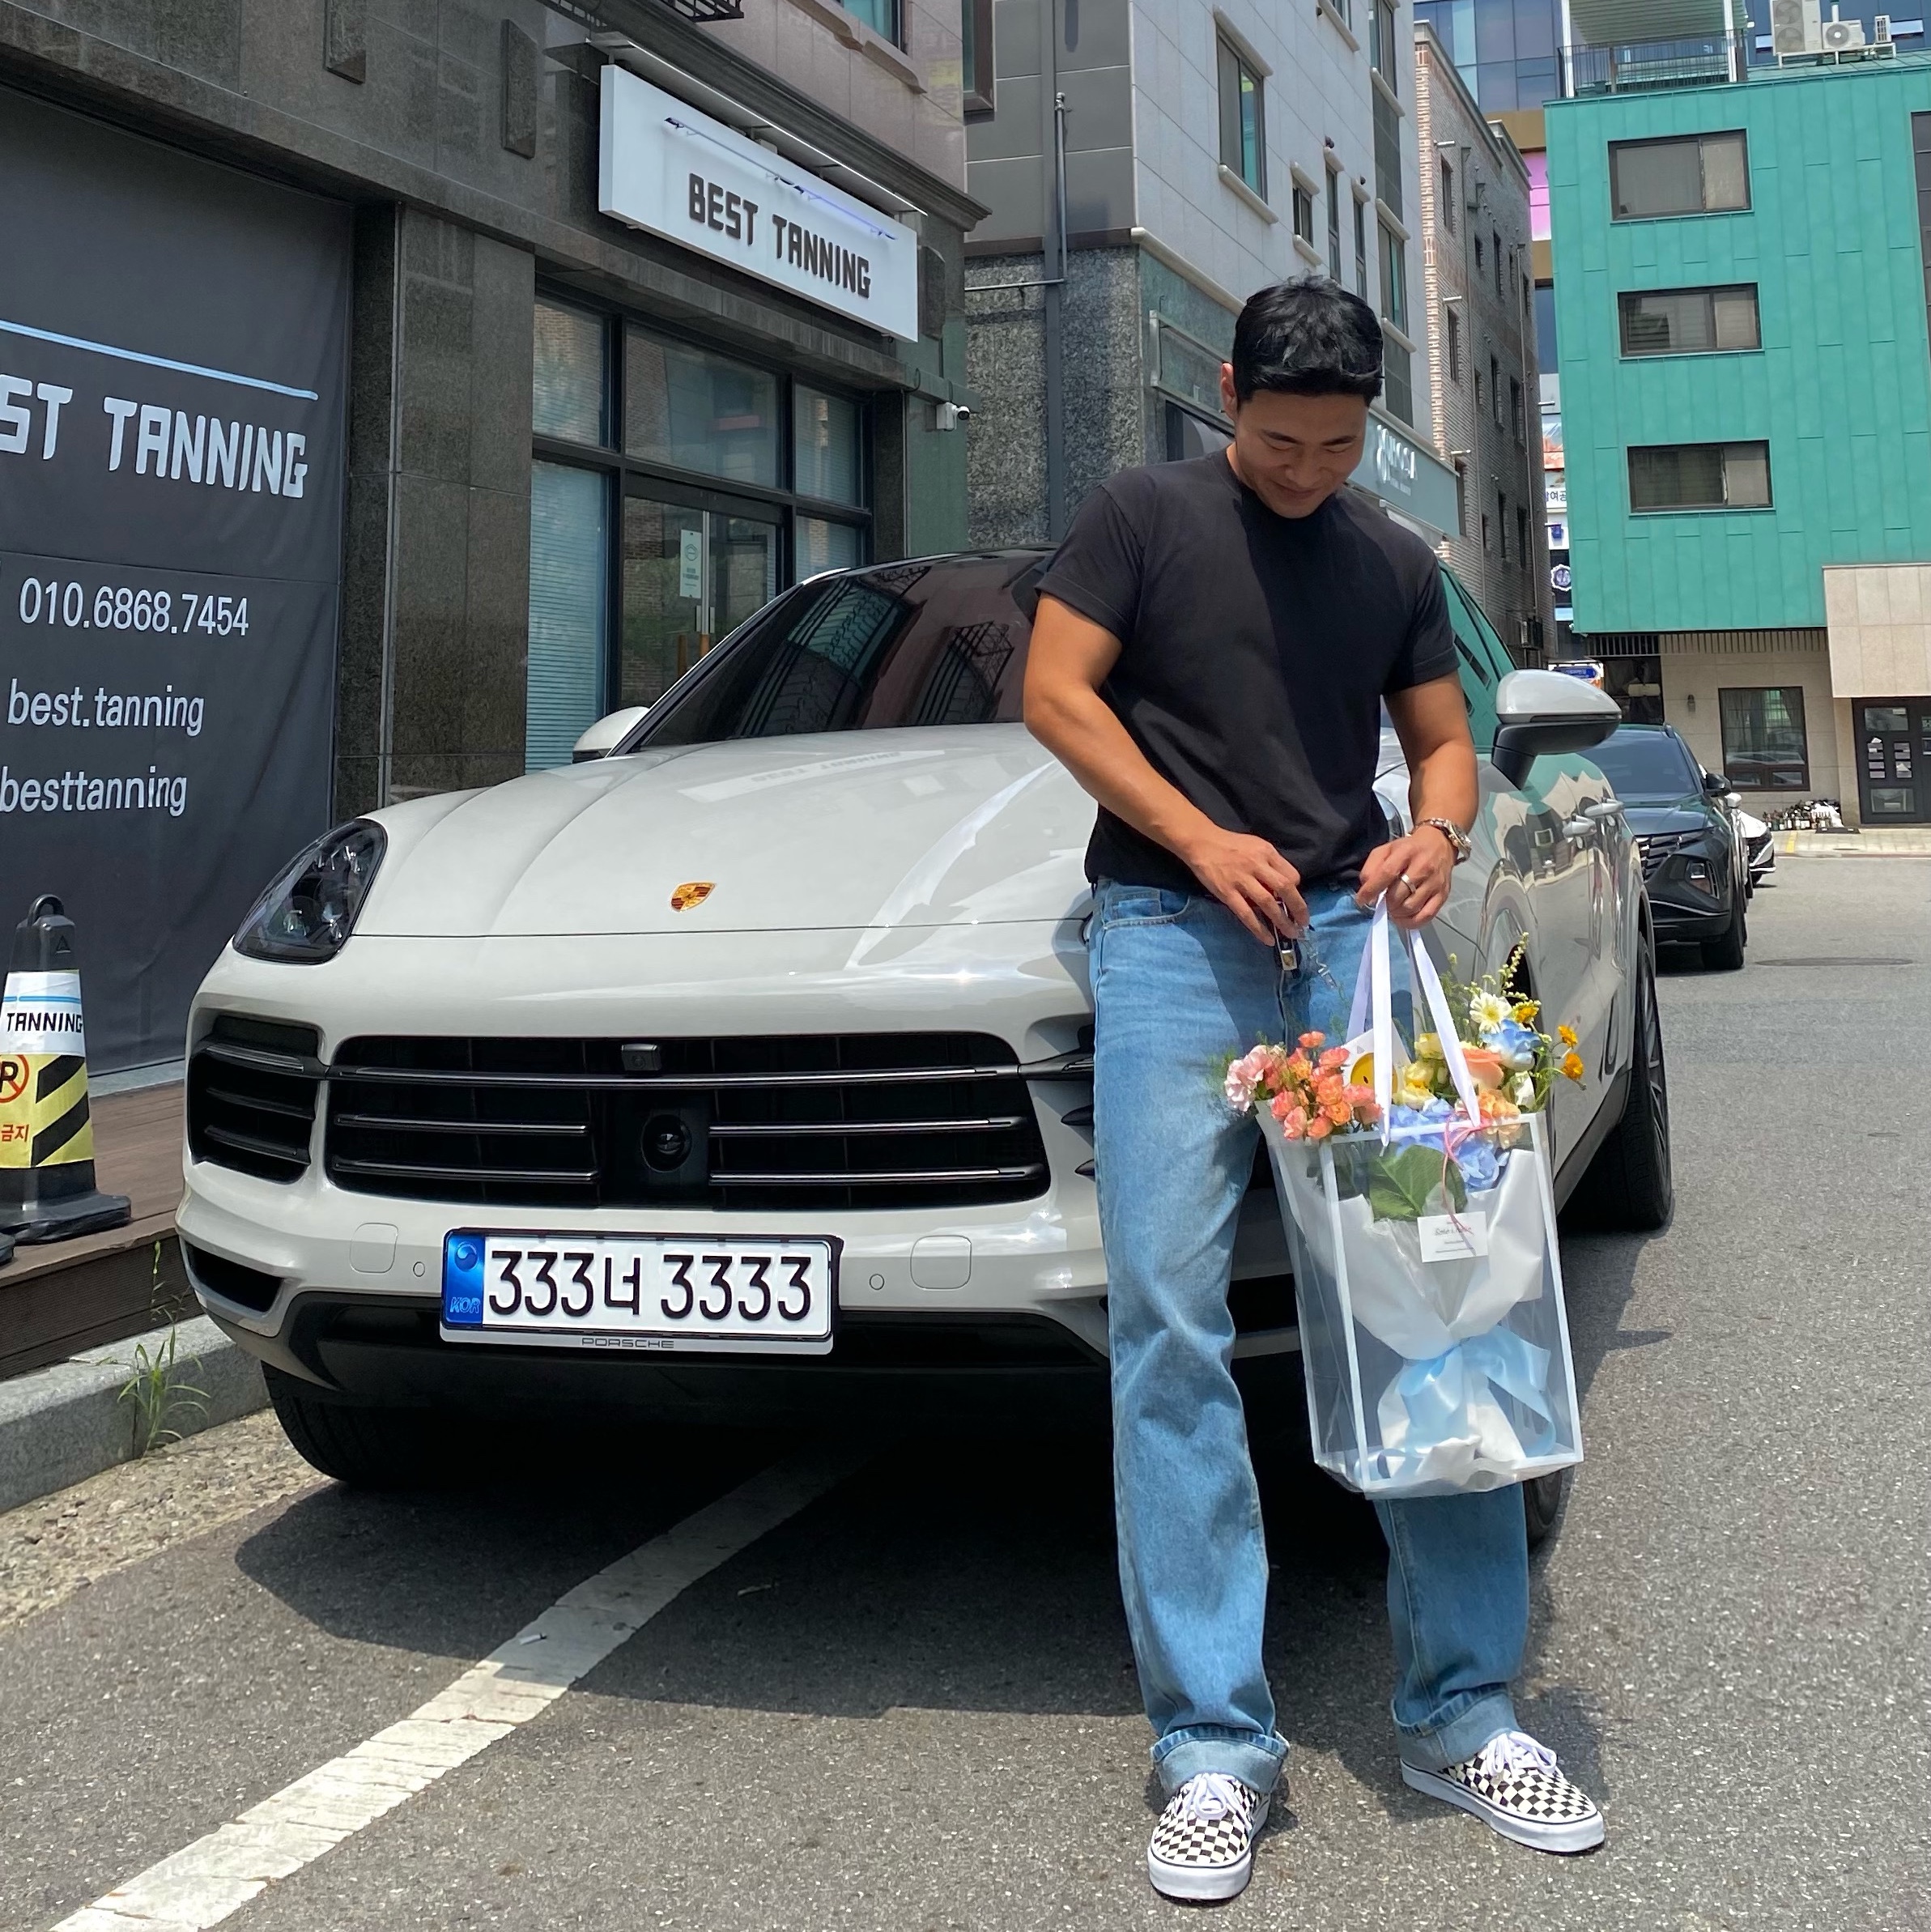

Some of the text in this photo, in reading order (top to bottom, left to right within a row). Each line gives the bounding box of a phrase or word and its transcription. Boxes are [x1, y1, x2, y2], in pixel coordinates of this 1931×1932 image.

[688, 172, 871, 299] BEST TANNING
[102, 396, 308, 500] TANNING
[19, 577, 249, 636] 010.6868.7454
[7, 679, 205, 737] best.tanning
[0, 766, 188, 817] besttanning
[6, 1012, 83, 1033] TANNING
[1, 1124, 30, 1143] 금지
[449, 1296, 481, 1314] KOR
[489, 1251, 812, 1321] 333너 3333
[581, 1338, 674, 1349] PORSCHE
